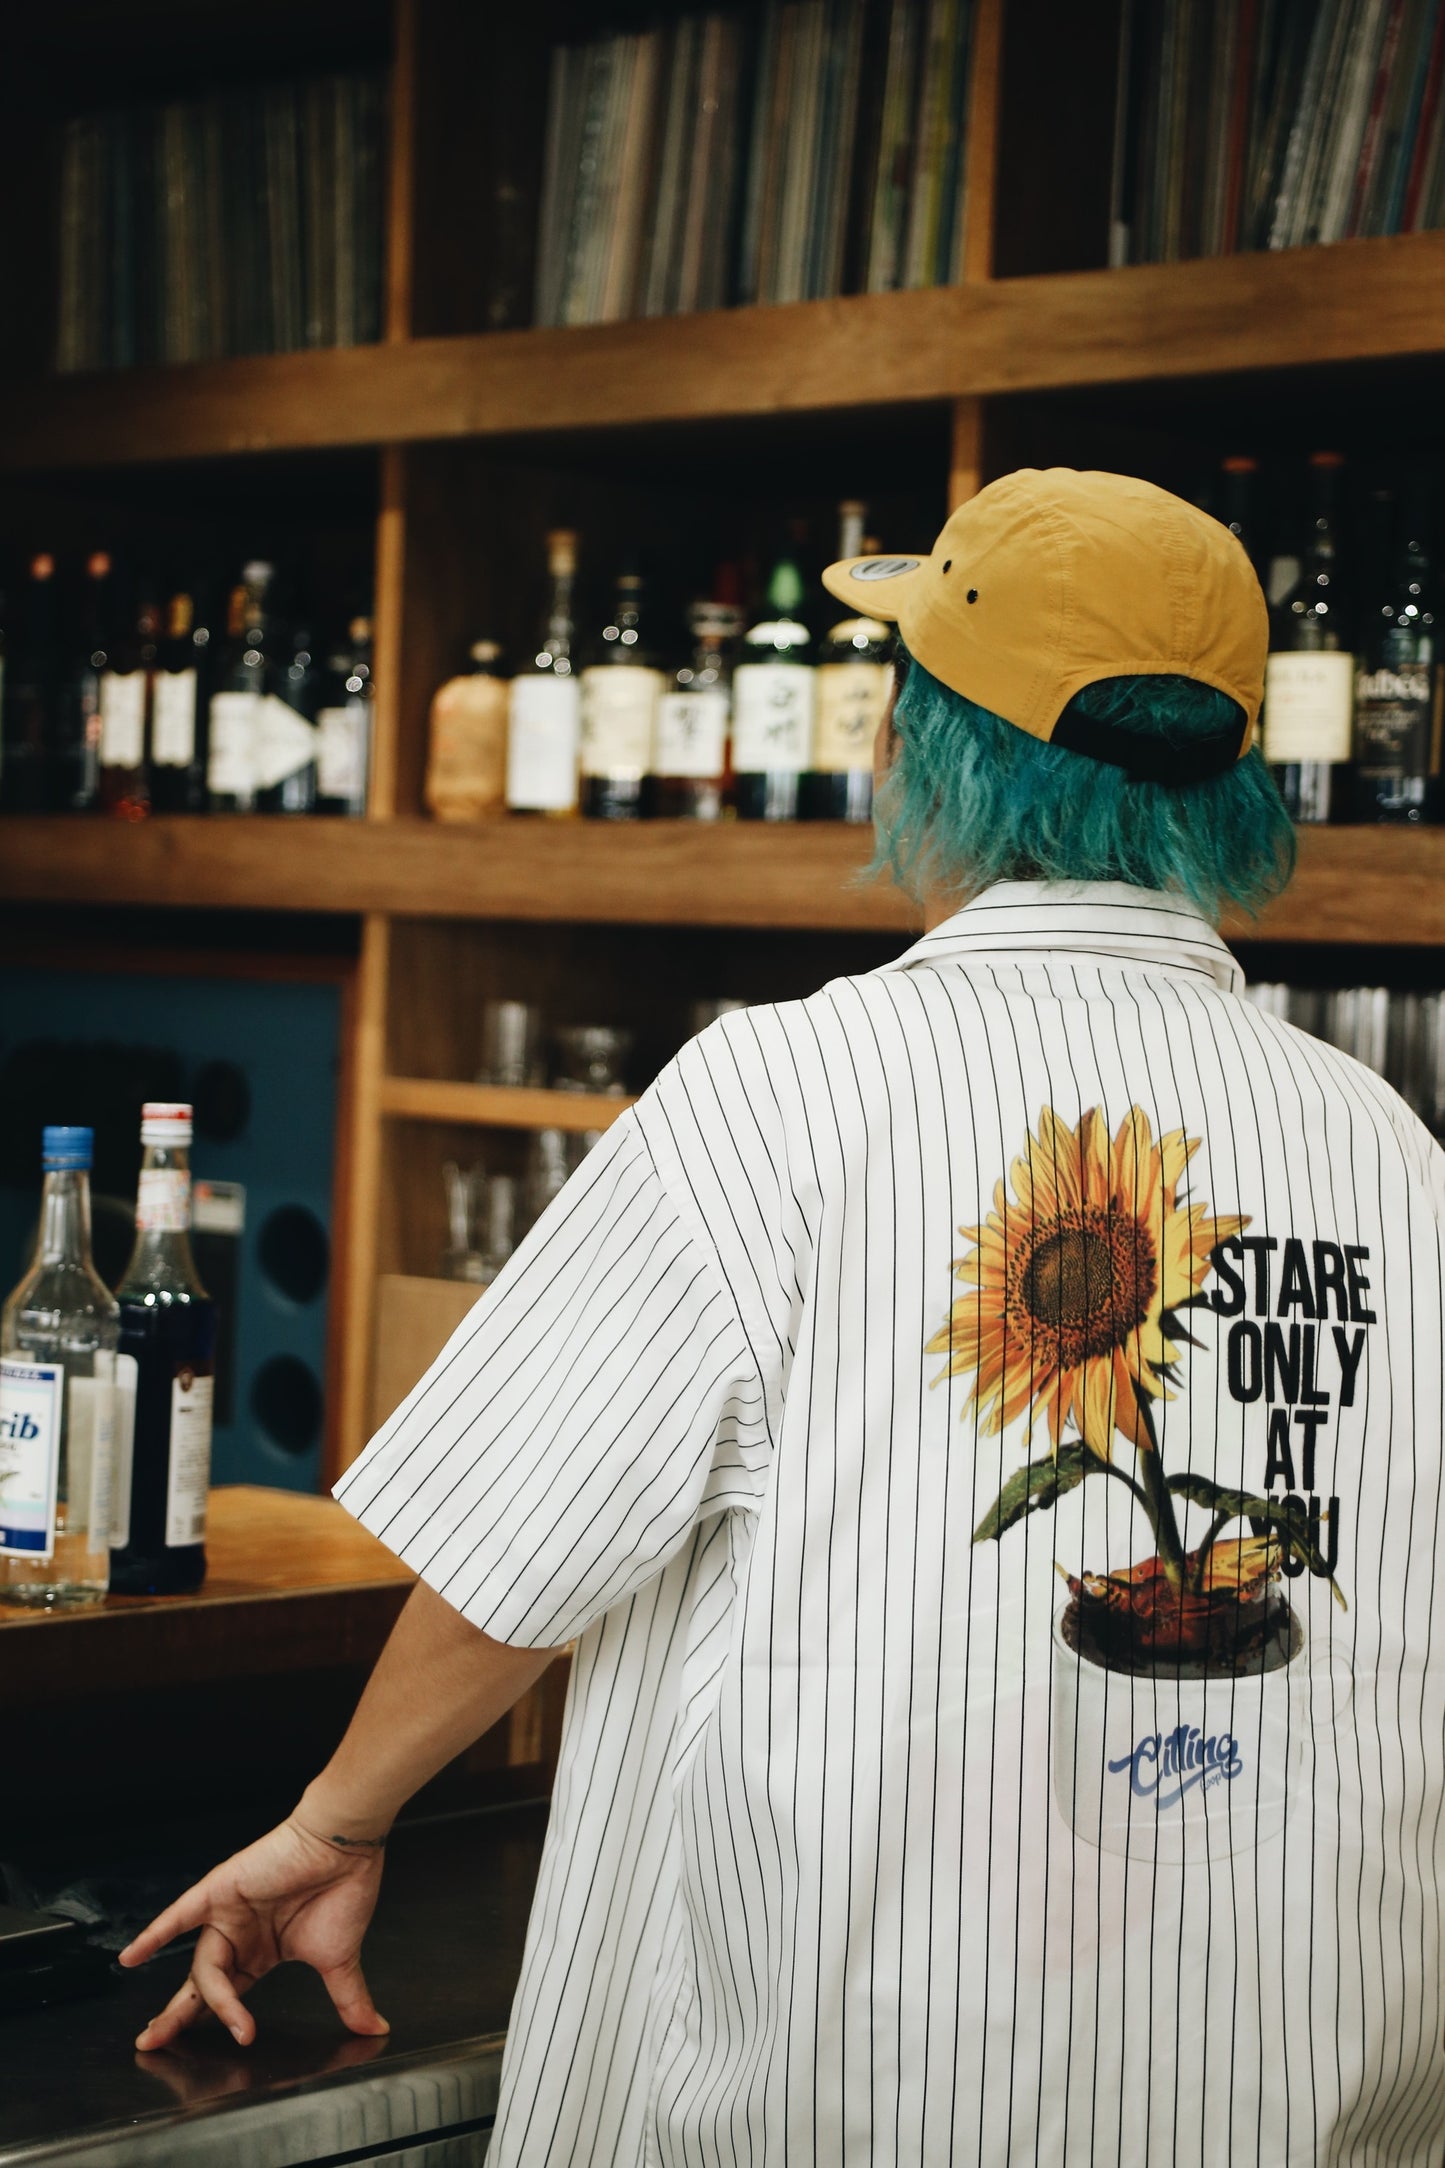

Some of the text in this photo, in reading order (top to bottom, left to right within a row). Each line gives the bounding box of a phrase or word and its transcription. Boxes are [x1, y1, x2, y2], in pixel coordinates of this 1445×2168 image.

[1209, 1235, 1377, 1324] STARE
[1228, 1320, 1366, 1407] ONLY
[1264, 1408, 1328, 1491] AT
